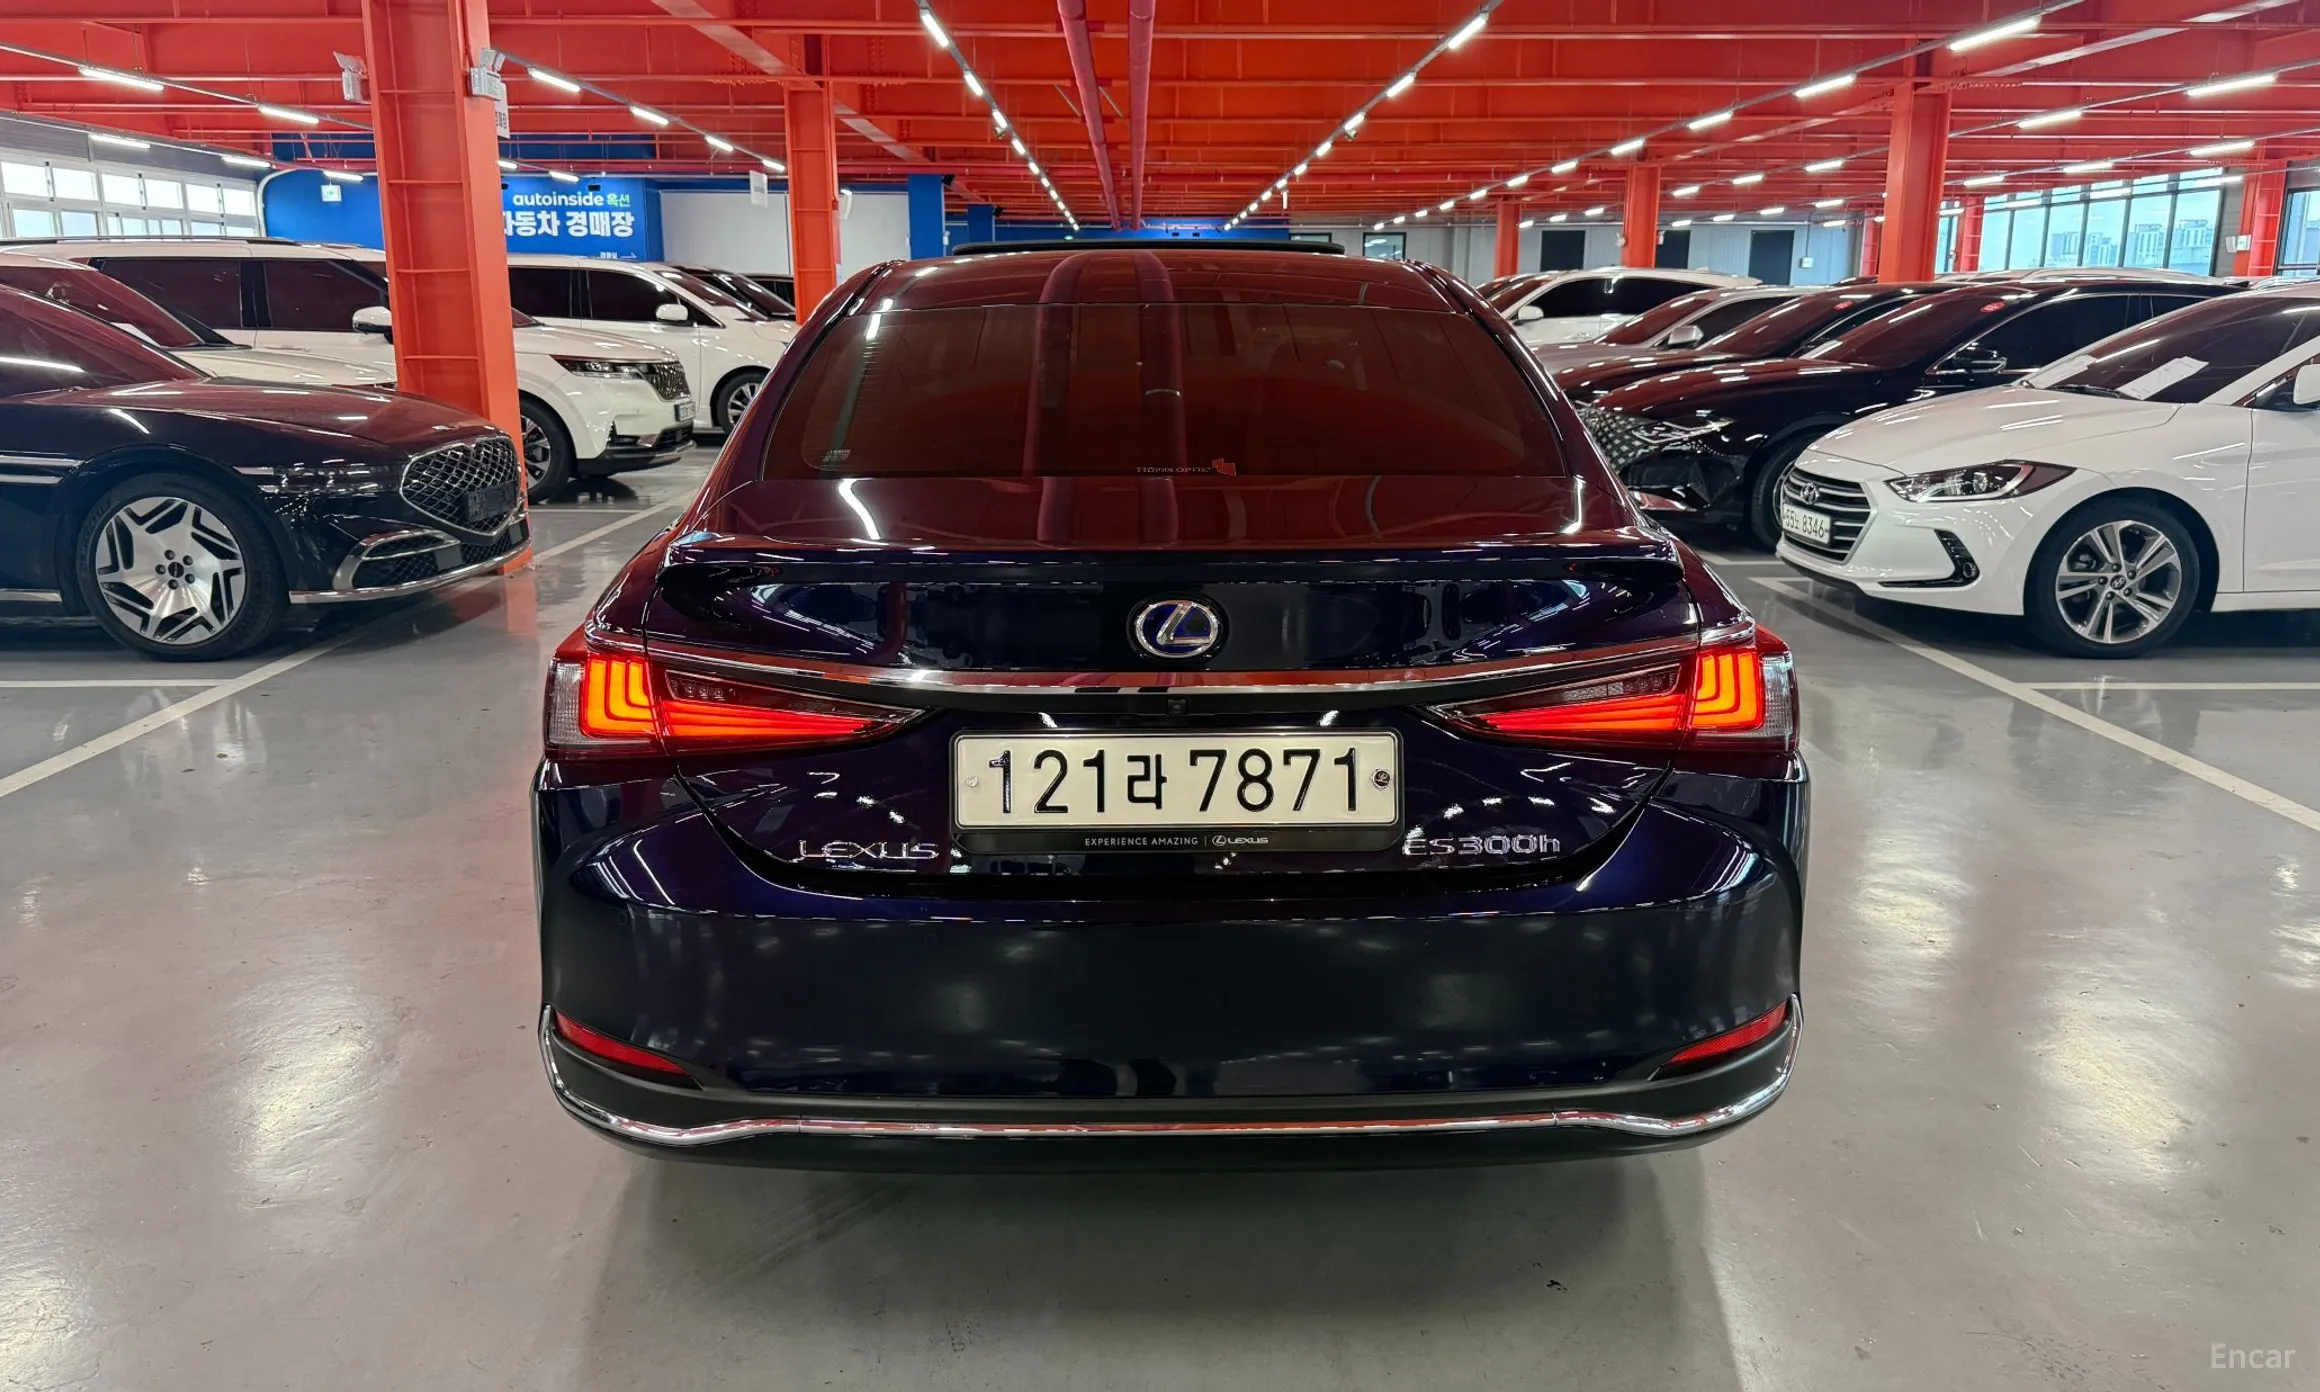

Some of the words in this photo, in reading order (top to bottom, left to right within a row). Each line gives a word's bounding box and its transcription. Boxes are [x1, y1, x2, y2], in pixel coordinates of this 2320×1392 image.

[513, 191, 604, 206] autoinside
[607, 193, 631, 207] 옥션
[503, 211, 560, 237] 동차
[566, 211, 635, 237] 경매장
[1802, 514, 1824, 538] 8346
[988, 748, 1168, 814] 121라
[1189, 747, 1358, 813] 7871
[799, 839, 939, 859] LEXUS
[1085, 837, 1148, 847] EXPERIENCE
[1151, 837, 1199, 846] AMAZING
